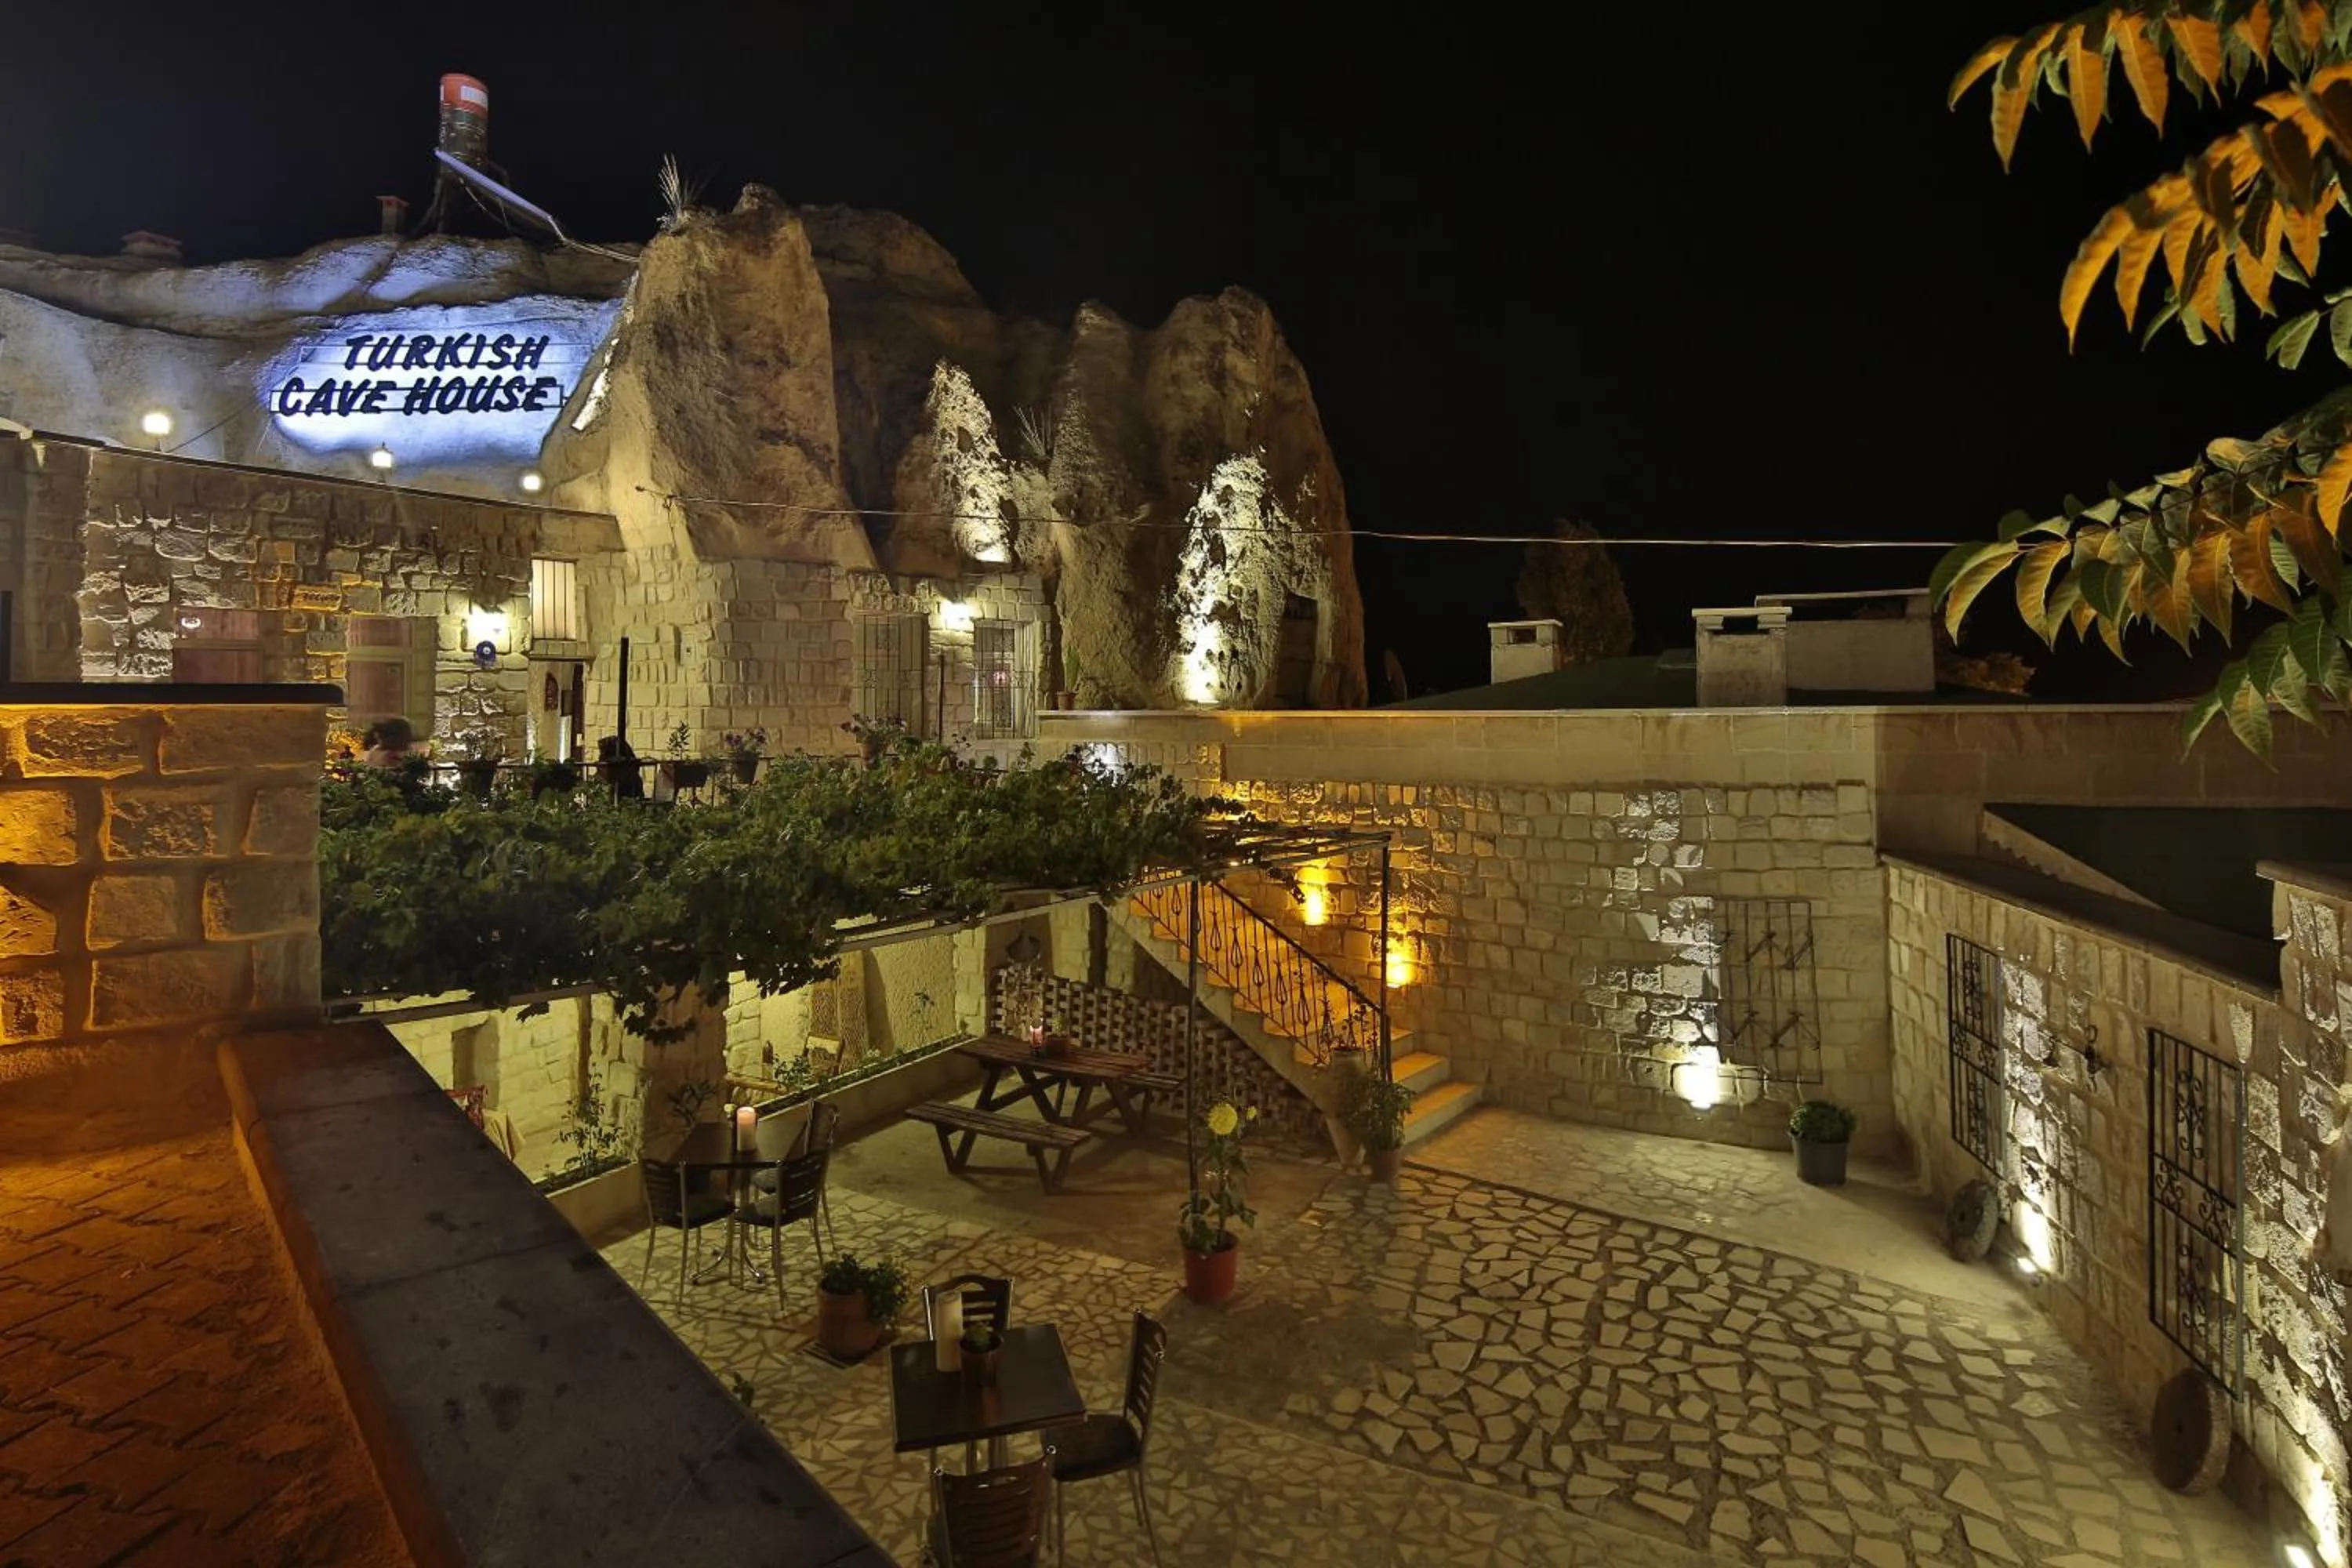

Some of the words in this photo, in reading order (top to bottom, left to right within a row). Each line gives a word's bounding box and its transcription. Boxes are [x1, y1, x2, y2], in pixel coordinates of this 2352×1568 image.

[345, 333, 550, 371] TURKISH
[279, 377, 397, 416] CAVE
[403, 375, 557, 416] HOUSE
